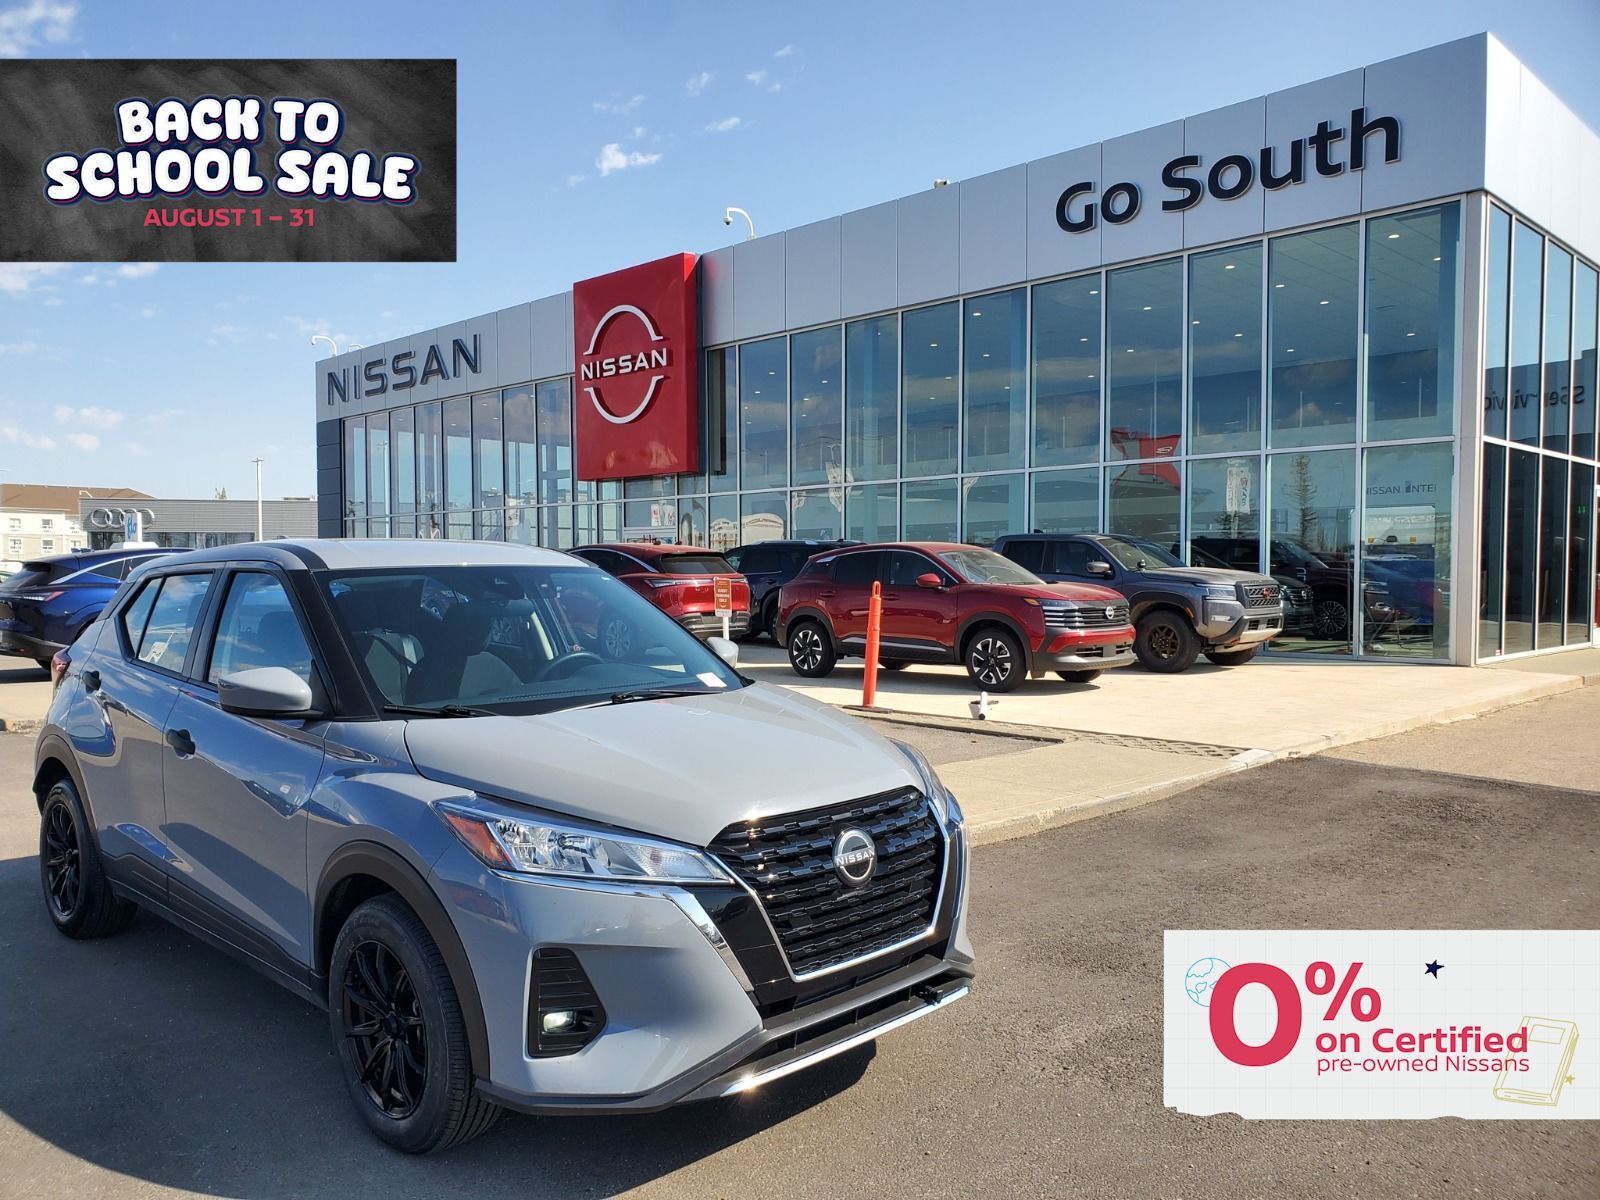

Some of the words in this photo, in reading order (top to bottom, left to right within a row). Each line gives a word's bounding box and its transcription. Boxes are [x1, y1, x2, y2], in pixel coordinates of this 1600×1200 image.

[1055, 181, 1142, 233] Go
[1161, 106, 1402, 212] South
[327, 333, 481, 406] NISSAN
[581, 347, 667, 381] NISSAN
[836, 846, 875, 866] NISSAN
